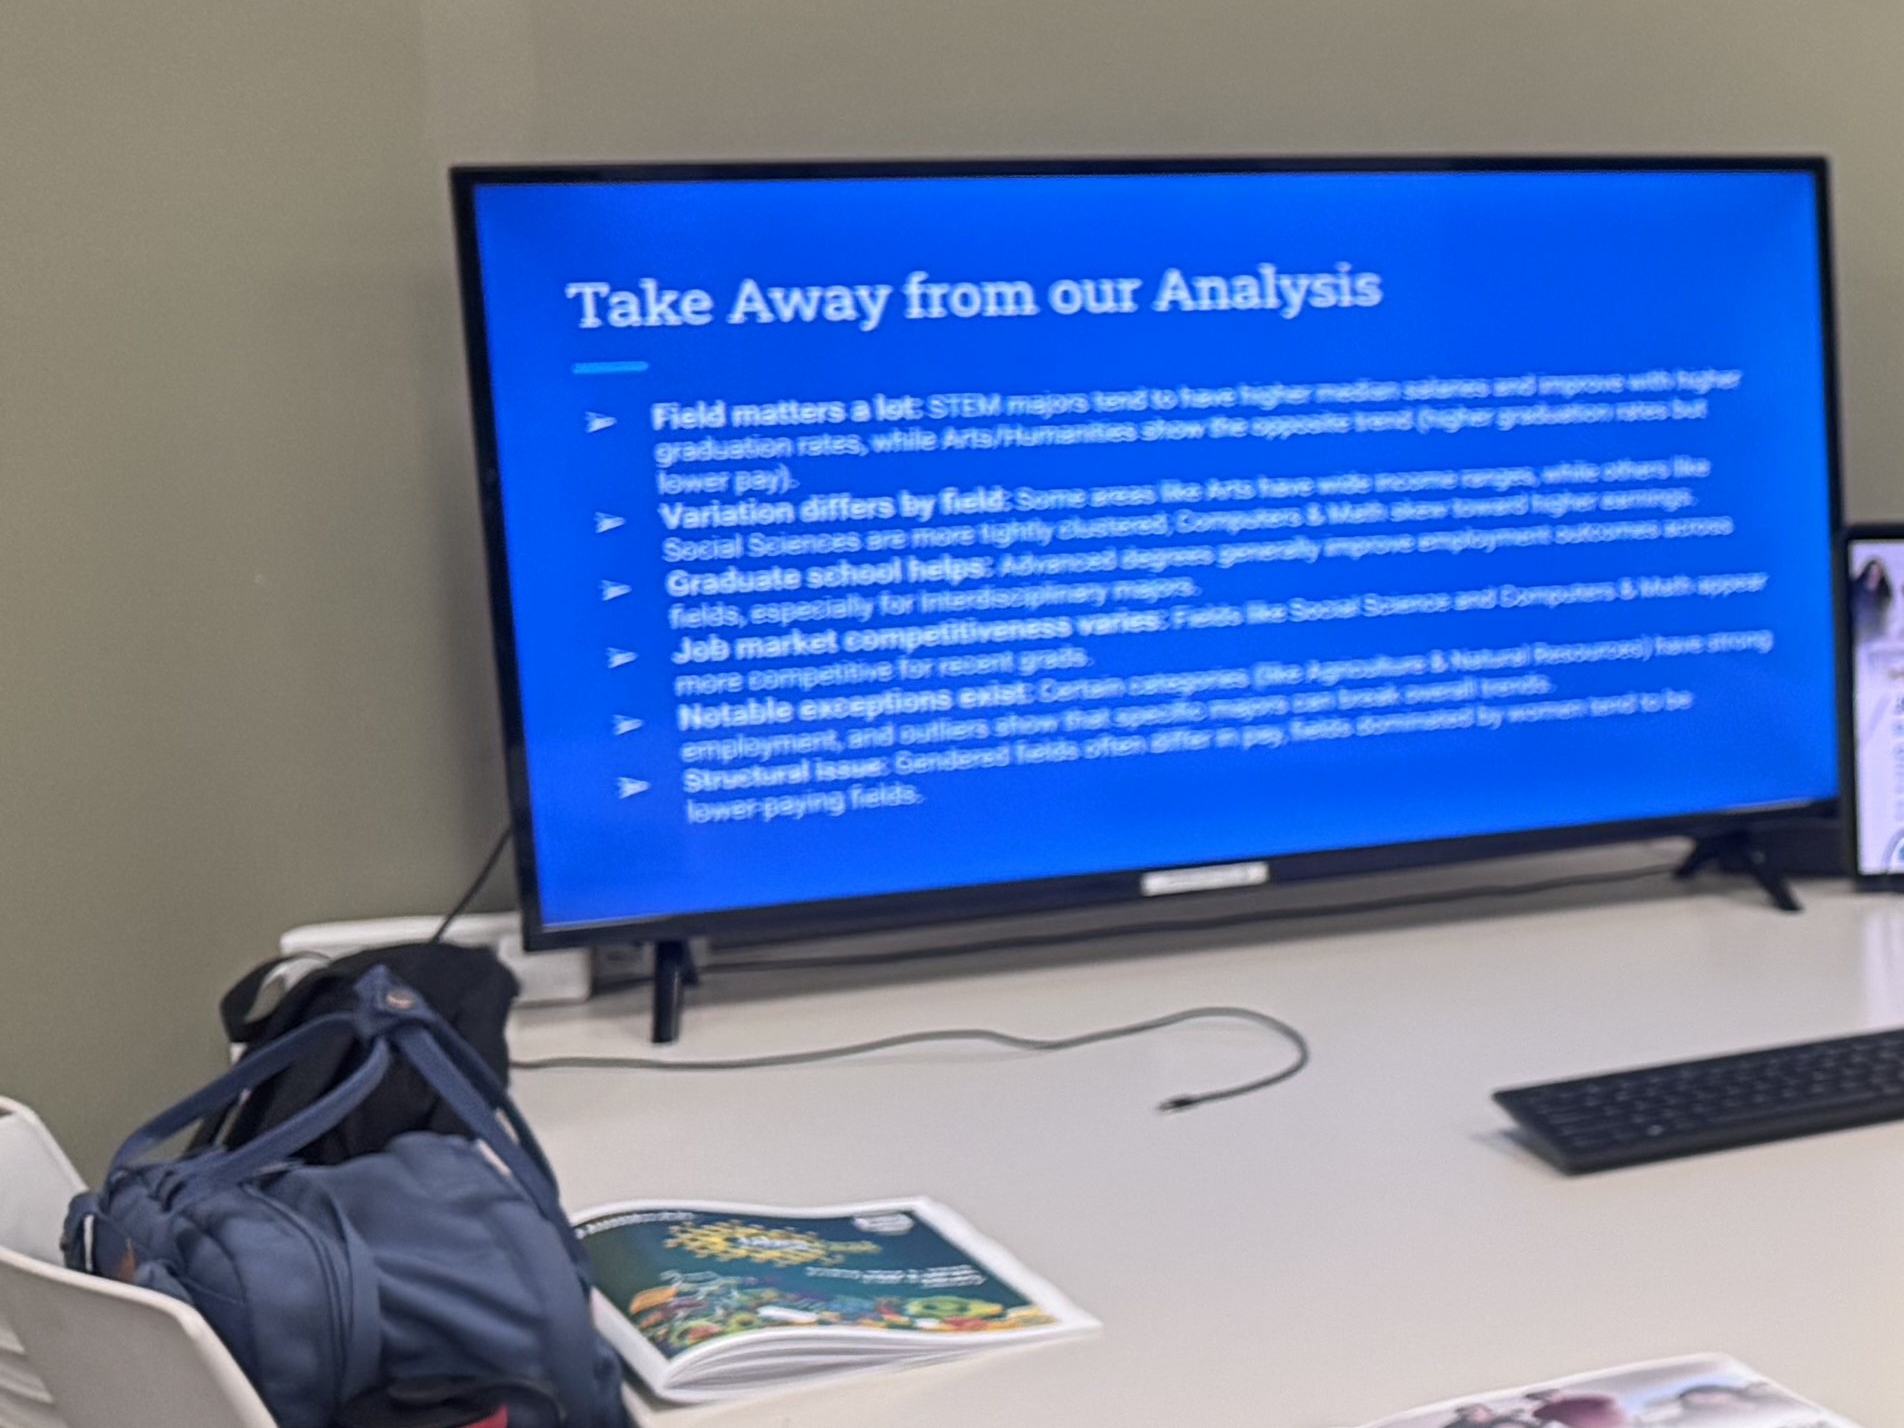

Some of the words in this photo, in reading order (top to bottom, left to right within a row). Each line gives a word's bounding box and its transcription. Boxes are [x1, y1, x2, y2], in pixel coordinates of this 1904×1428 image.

[566, 278, 713, 328] Take
[726, 278, 892, 332] Away
[903, 271, 1040, 317] from
[1049, 279, 1143, 315] our
[1151, 262, 1382, 319] Analysis
[650, 399, 727, 429] Field
[731, 399, 846, 425] matters
[850, 401, 871, 420] a
[874, 394, 925, 419] lot:
[659, 499, 795, 528] Variation
[799, 493, 895, 520] differs
[899, 491, 935, 520] by
[939, 487, 1012, 513] field:
[665, 566, 801, 595] Graduate
[806, 558, 903, 587] school
[906, 555, 994, 584] helps:
[670, 634, 730, 662] Job
[735, 629, 838, 658] market
[843, 618, 1072, 653] competitiveness
[676, 697, 793, 729] Notable
[798, 690, 953, 721] exceptions
[682, 759, 811, 791] Structural
